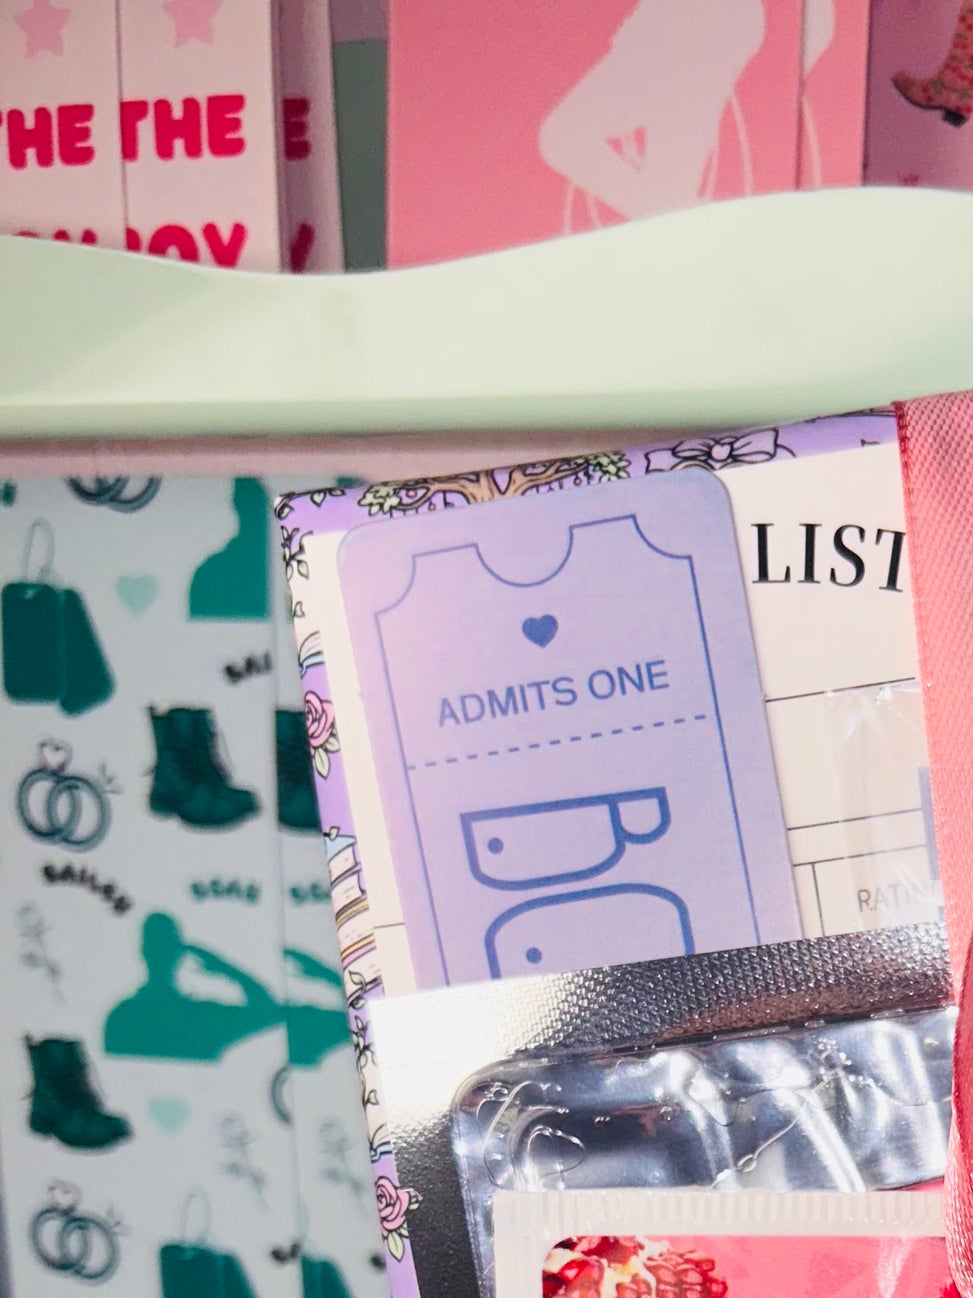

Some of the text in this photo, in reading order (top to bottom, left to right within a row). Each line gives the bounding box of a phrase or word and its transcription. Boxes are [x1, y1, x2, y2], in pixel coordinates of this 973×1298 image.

[0, 103, 95, 170] HE
[120, 94, 247, 162] THE
[750, 522, 906, 593] LIST
[438, 659, 670, 728] ADMITS ONE
